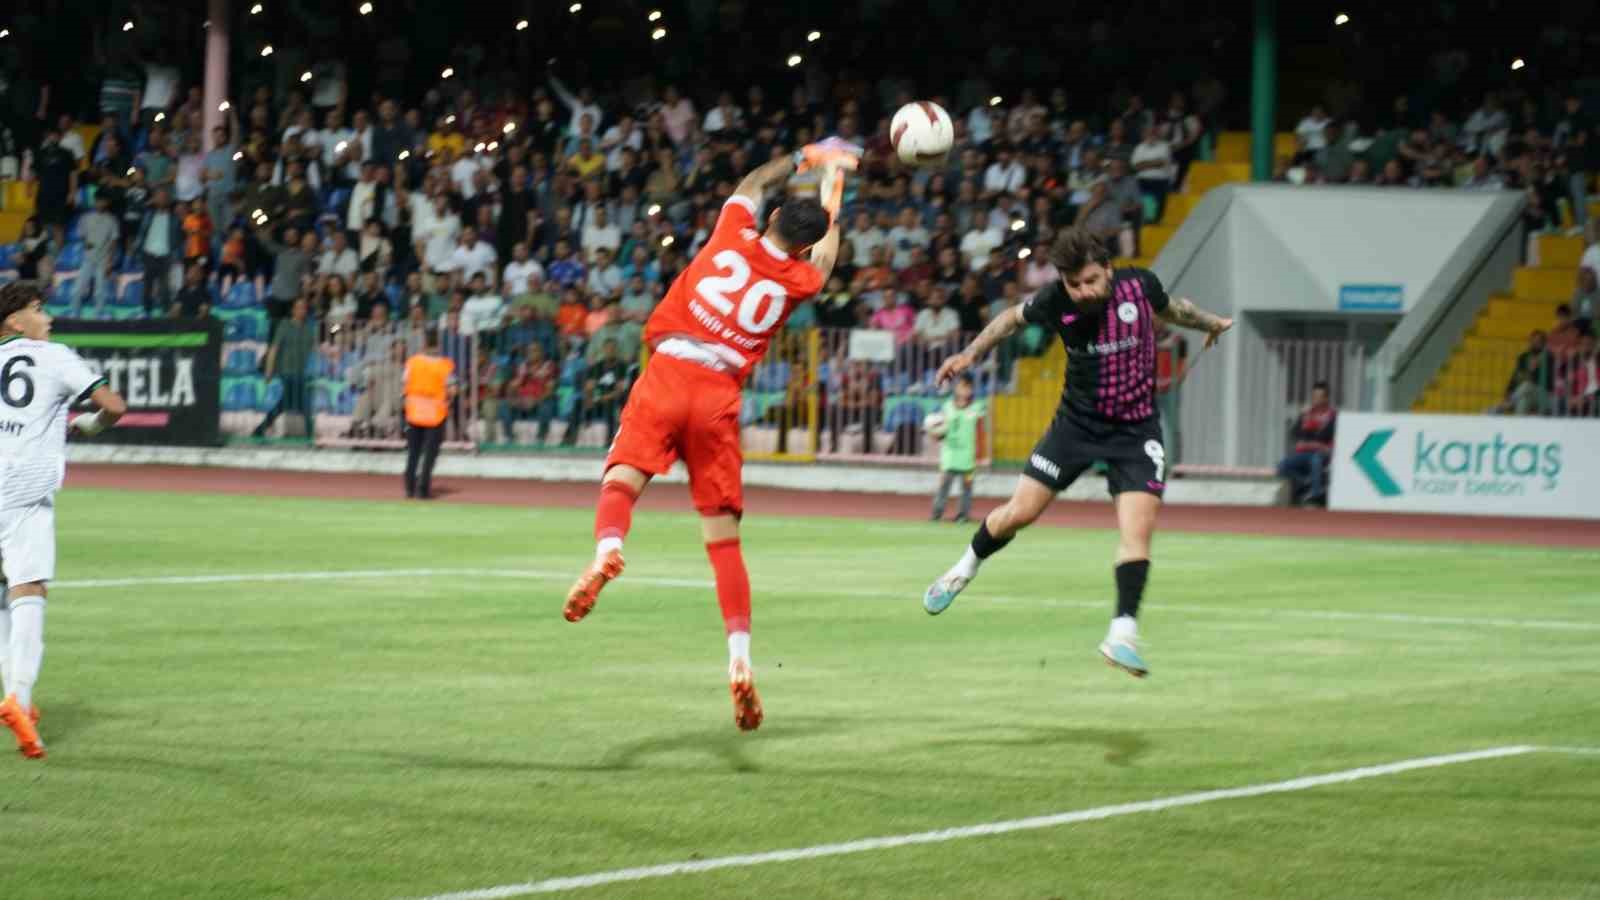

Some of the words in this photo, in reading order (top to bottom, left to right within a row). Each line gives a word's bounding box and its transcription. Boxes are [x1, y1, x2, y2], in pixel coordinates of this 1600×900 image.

[695, 249, 788, 335] 20
[0, 355, 36, 408] 6
[1143, 439, 1165, 482] 9
[1413, 430, 1562, 489] kartaş
